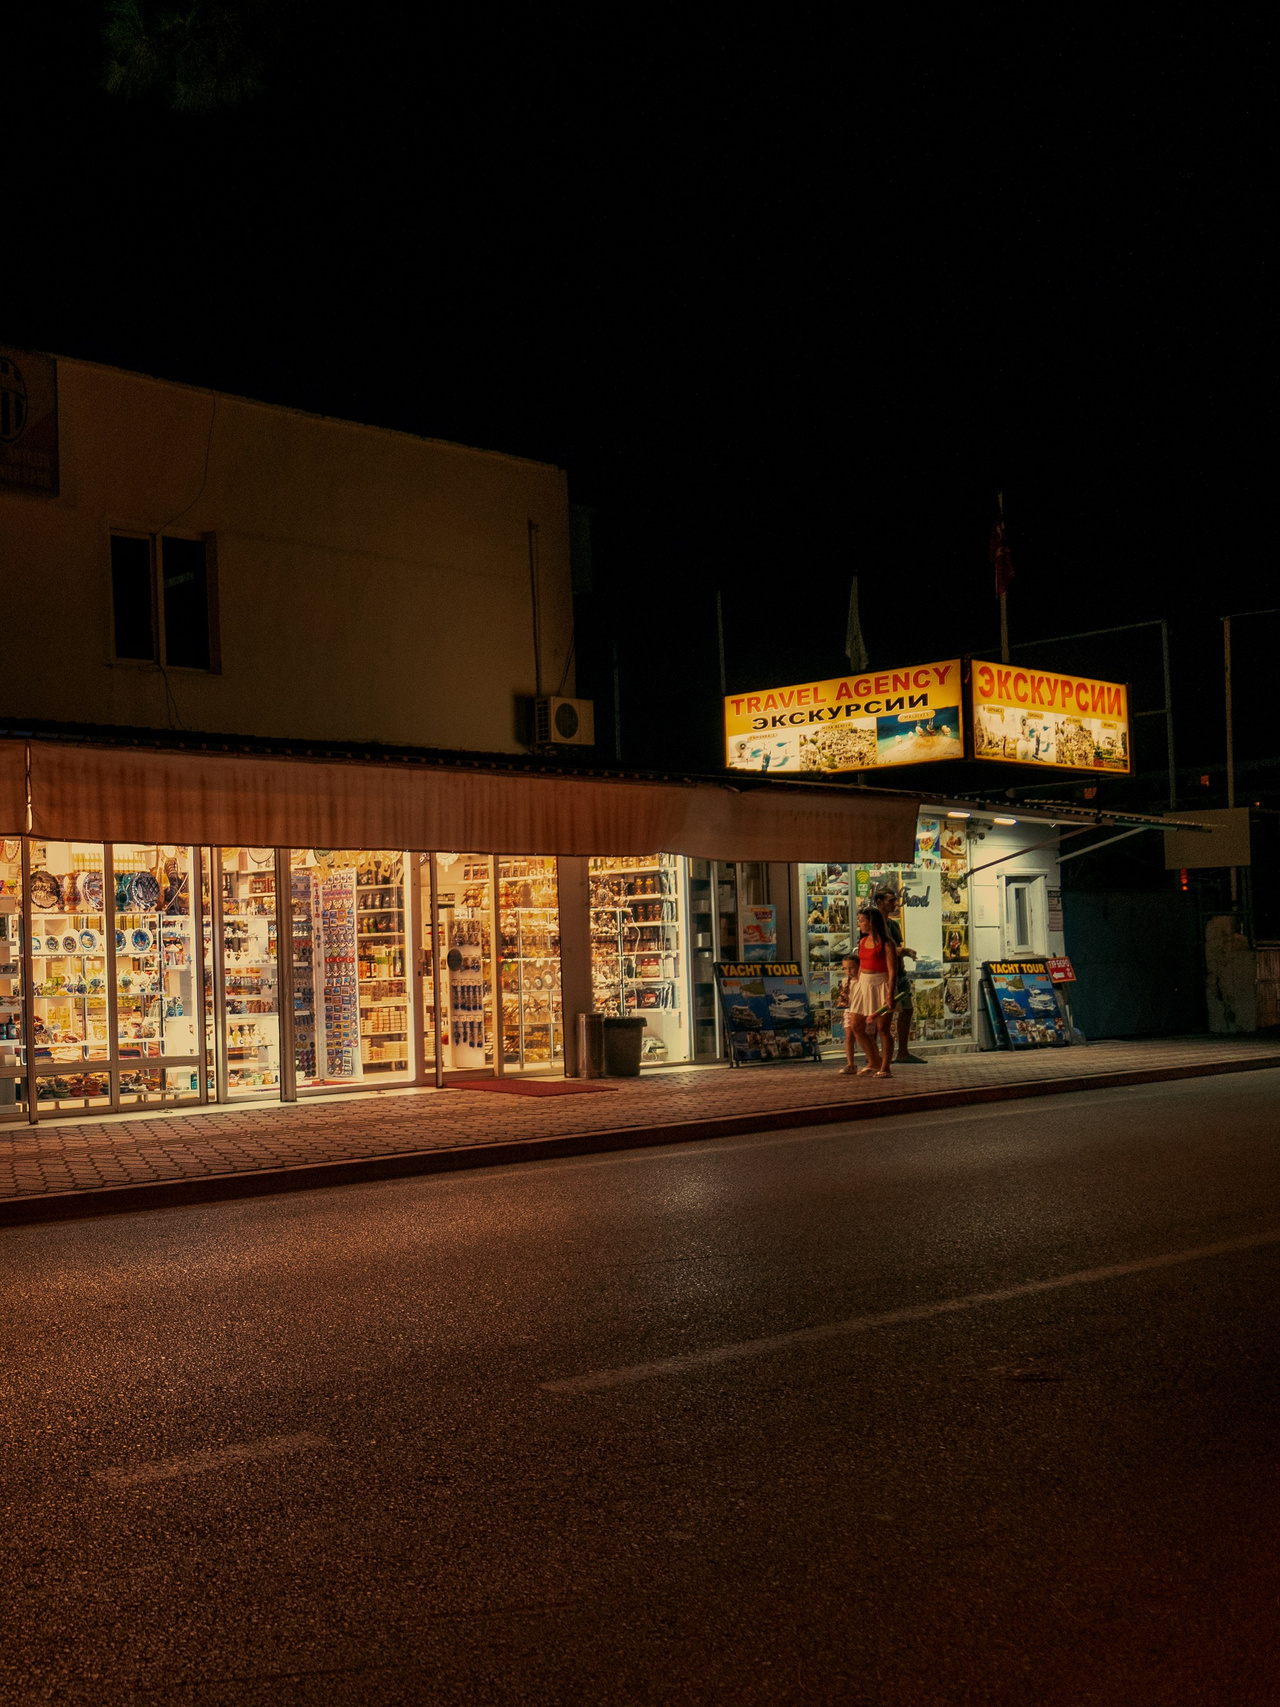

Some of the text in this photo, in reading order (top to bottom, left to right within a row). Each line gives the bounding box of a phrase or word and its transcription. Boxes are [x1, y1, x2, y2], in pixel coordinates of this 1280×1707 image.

[730, 664, 953, 716] TRAVEL AGENCY
[977, 665, 1122, 716] ЭКСКУРСИИ
[751, 693, 929, 730] ЭКСКУРСИИ
[720, 963, 800, 977] YACHT TOUR
[989, 963, 1047, 974] YACHT TOUR
